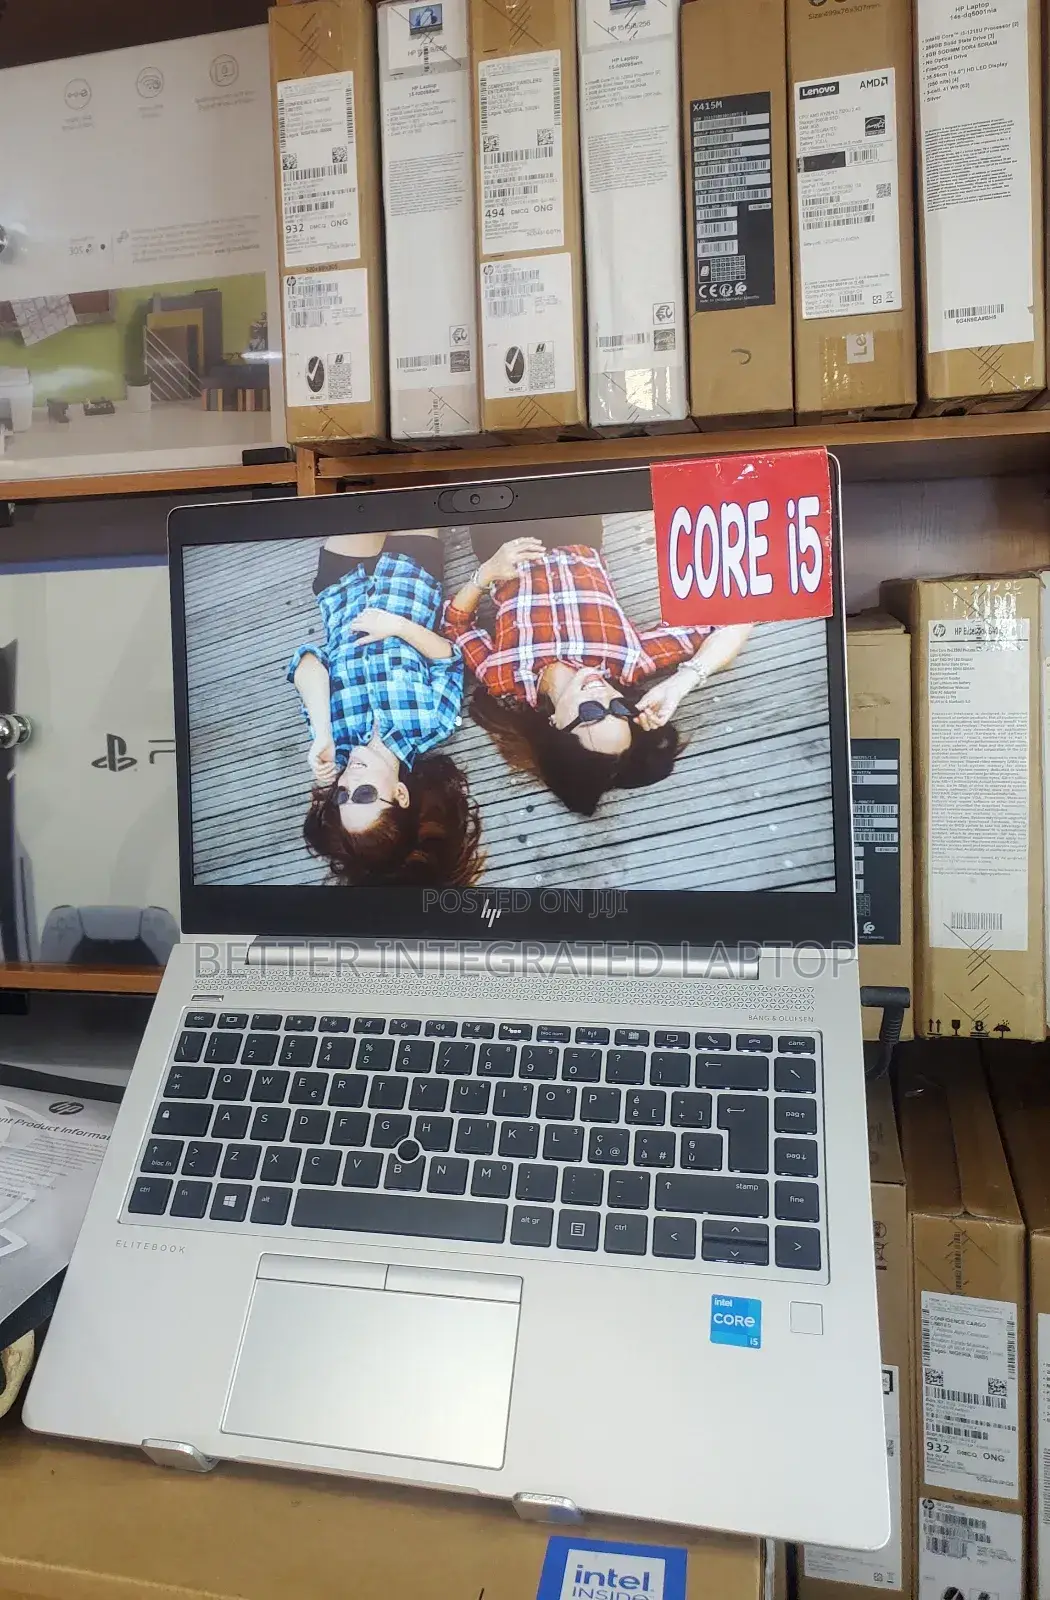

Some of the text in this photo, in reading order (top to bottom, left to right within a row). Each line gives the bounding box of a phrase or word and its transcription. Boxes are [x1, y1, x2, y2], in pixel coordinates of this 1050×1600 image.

[966, 2, 990, 10] Laptop
[984, 22, 1011, 32] Processor
[802, 85, 836, 97] Lenovo
[860, 79, 880, 90] AMD
[693, 100, 722, 112] X415M
[485, 208, 504, 218] 494
[534, 204, 553, 212] ONG
[286, 224, 304, 234] 932
[330, 219, 348, 228] ONG
[669, 496, 822, 600] CORE i5
[286, 1052, 292, 1060] 3
[362, 1056, 370, 1064] 5
[484, 1062, 492, 1070] 8
[526, 1064, 534, 1072] 9
[222, 1074, 232, 1083] Q
[261, 1076, 273, 1084] W
[298, 1078, 306, 1086] E
[338, 1080, 346, 1088] R
[378, 1082, 386, 1090] T
[460, 1086, 468, 1095] U
[546, 1092, 556, 1100] O
[590, 1094, 597, 1103] P
[14, 1118, 60, 1132] Product
[222, 1112, 230, 1120] A
[260, 1114, 268, 1122] S
[300, 1116, 308, 1124] D
[382, 1120, 390, 1130] G
[422, 1124, 431, 1132] H
[464, 1126, 472, 1135] J
[508, 1130, 516, 1138] K
[552, 1132, 560, 1142] L
[610, 1148, 620, 1156] @
[230, 1152, 492, 1178] Z X C V B N M
[736, 1182, 758, 1190] stamp
[116, 1240, 186, 1254] ELITEBOOK
[714, 1298, 732, 1307] intel
[930, 1316, 965, 1324] CONFIDENCE
[926, 1442, 950, 1454] 932
[983, 1452, 1005, 1462] ONG
[574, 1564, 650, 1591] intel
